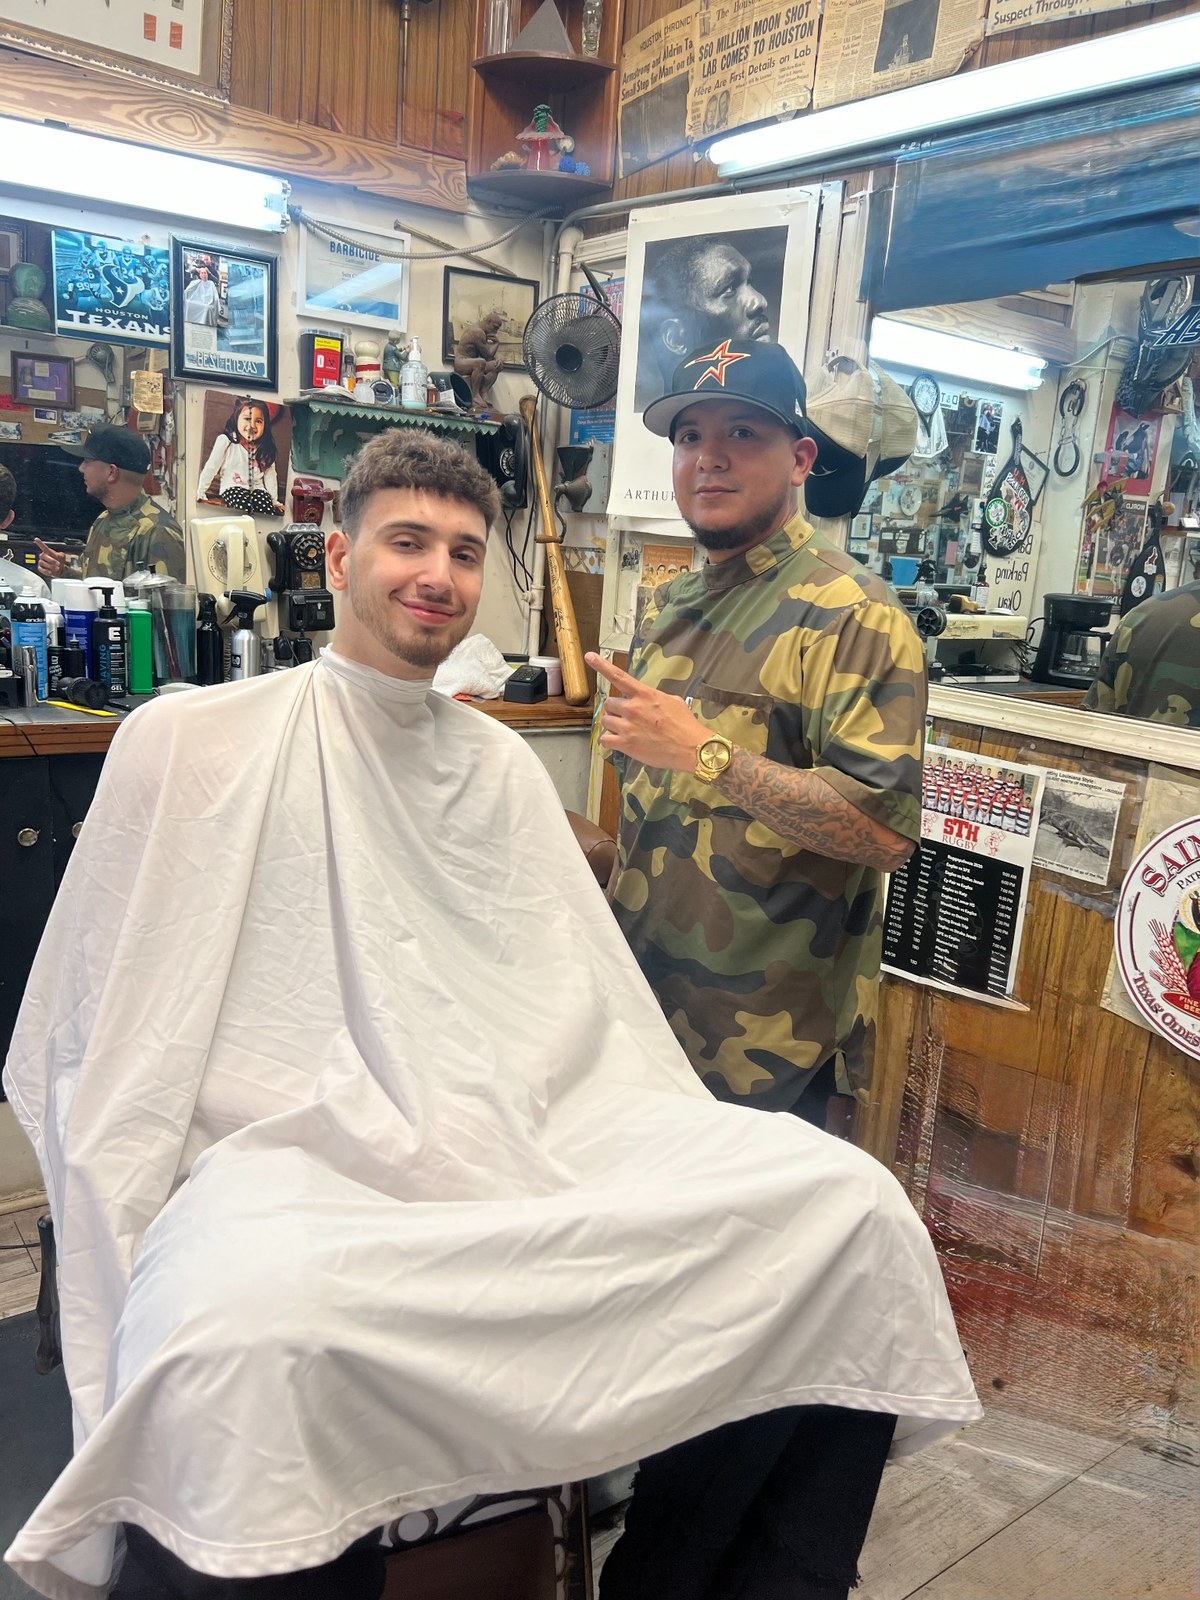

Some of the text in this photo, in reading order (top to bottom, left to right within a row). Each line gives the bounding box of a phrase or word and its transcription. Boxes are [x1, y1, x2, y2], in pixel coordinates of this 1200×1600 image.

[640, 12, 699, 50] HOUSTON CHRONIC
[699, 1, 811, 61] $60 MILLION MOON SHOT
[994, 6, 1032, 25] Suspect
[622, 63, 651, 85] Armstrong
[651, 52, 661, 69] and
[662, 43, 683, 61] Aldrin
[702, 59, 717, 78] LAB
[721, 44, 749, 71] COMES
[754, 39, 765, 57] TO
[768, 19, 815, 51] HOUSTON
[621, 82, 636, 101] Small
[636, 79, 650, 93] Step
[650, 72, 658, 85] for
[676, 60, 685, 71] on
[693, 85, 712, 97] Here
[713, 79, 727, 91] Are
[729, 69, 745, 84] First
[748, 57, 775, 77] Details
[780, 55, 790, 65] on
[794, 44, 811, 60] Lab
[95, 307, 148, 320] HOUSTON
[942, 834, 977, 851] RUGBY
[943, 818, 980, 842] STH
[1180, 996, 1199, 1007] FINE
